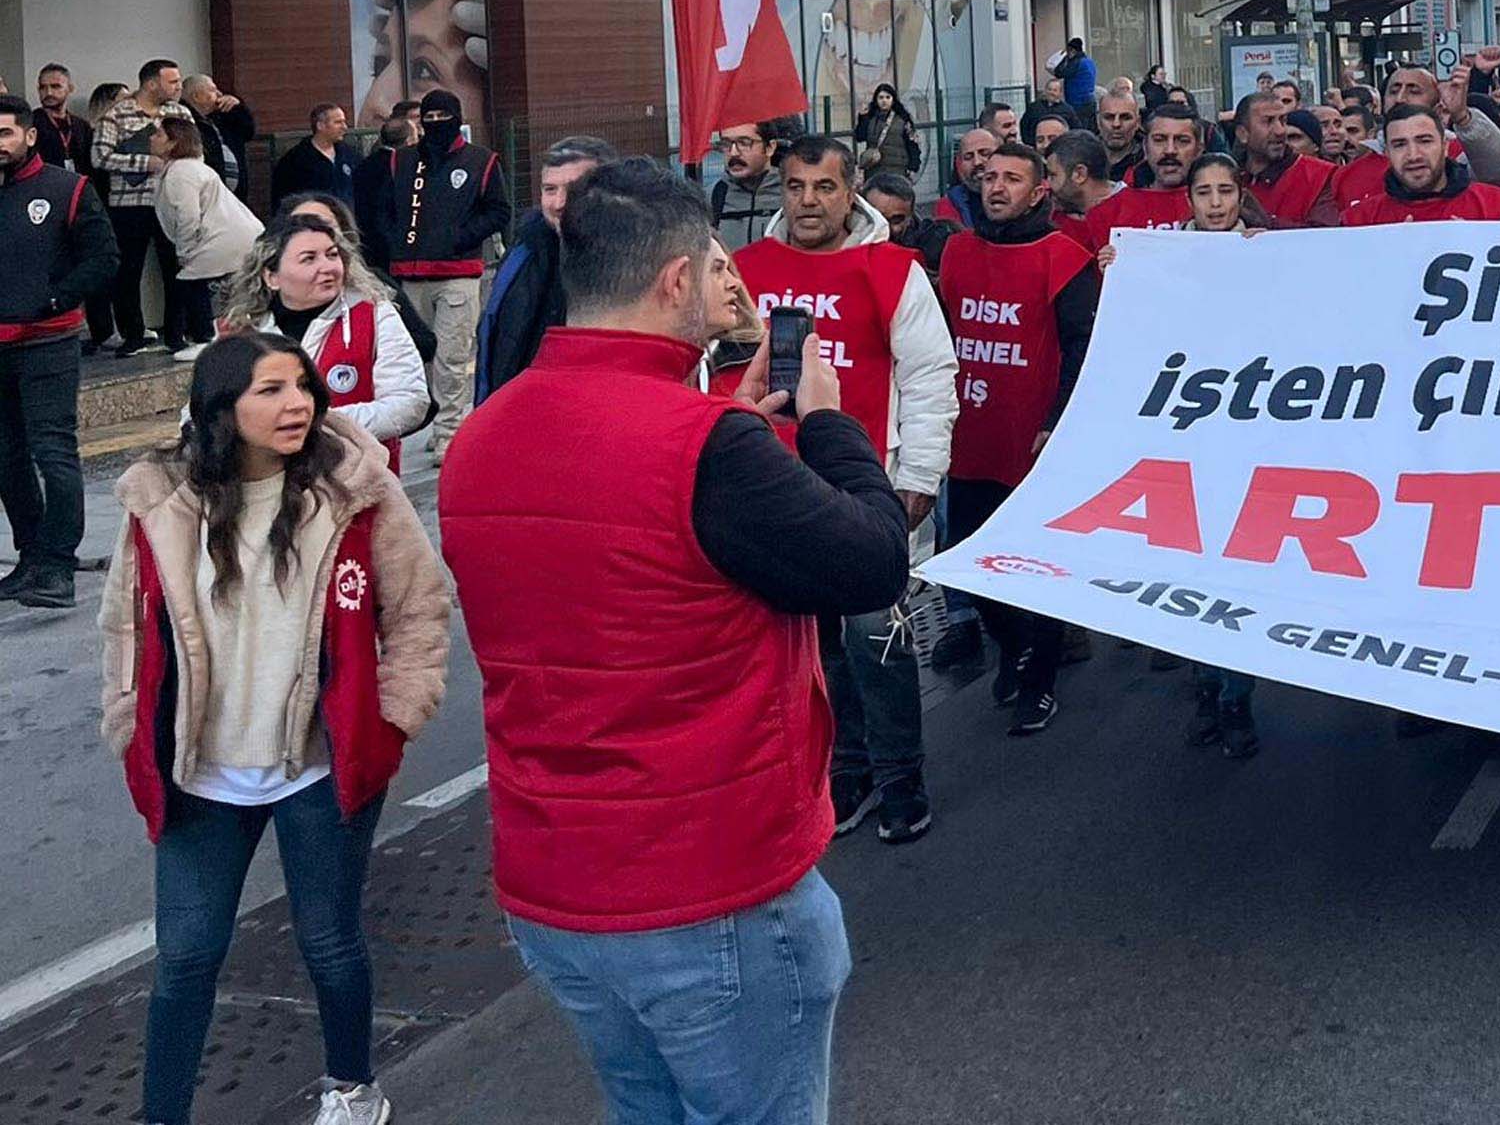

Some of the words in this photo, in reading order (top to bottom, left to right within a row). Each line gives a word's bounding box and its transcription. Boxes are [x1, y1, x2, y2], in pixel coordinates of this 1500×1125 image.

[960, 294, 1023, 326] DİSK
[963, 373, 989, 408] İŞ
[1138, 352, 1385, 430] işten
